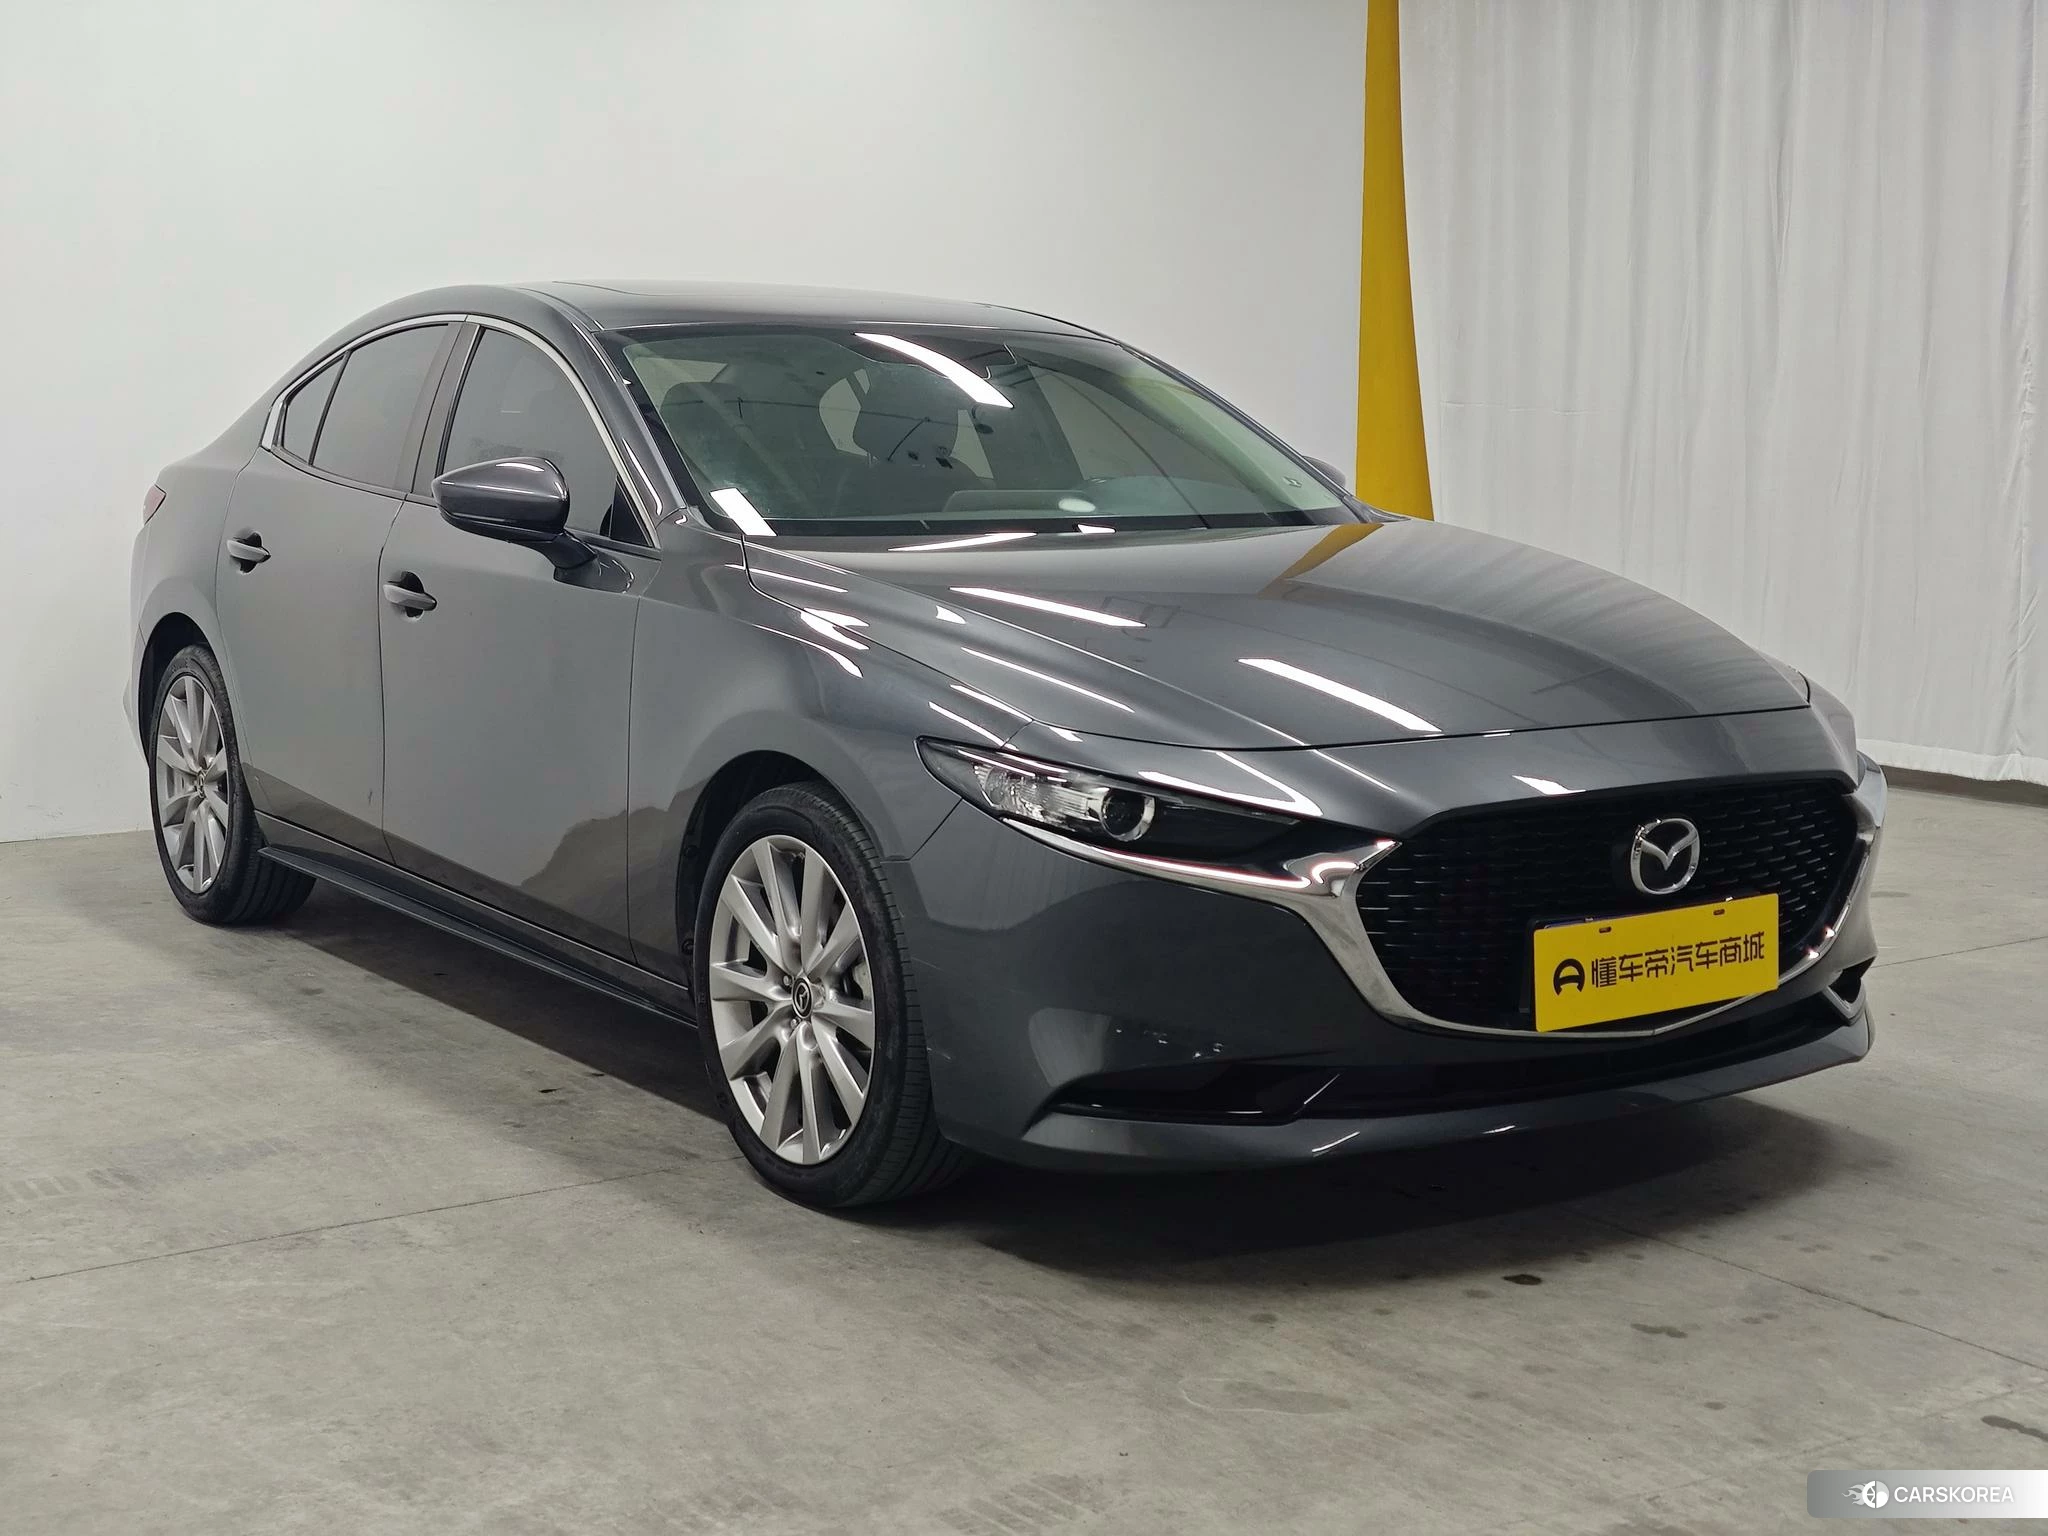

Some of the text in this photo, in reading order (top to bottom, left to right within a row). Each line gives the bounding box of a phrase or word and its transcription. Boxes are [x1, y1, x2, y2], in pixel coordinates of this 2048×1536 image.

[1591, 931, 1765, 988] 懂车帝汽车商城
